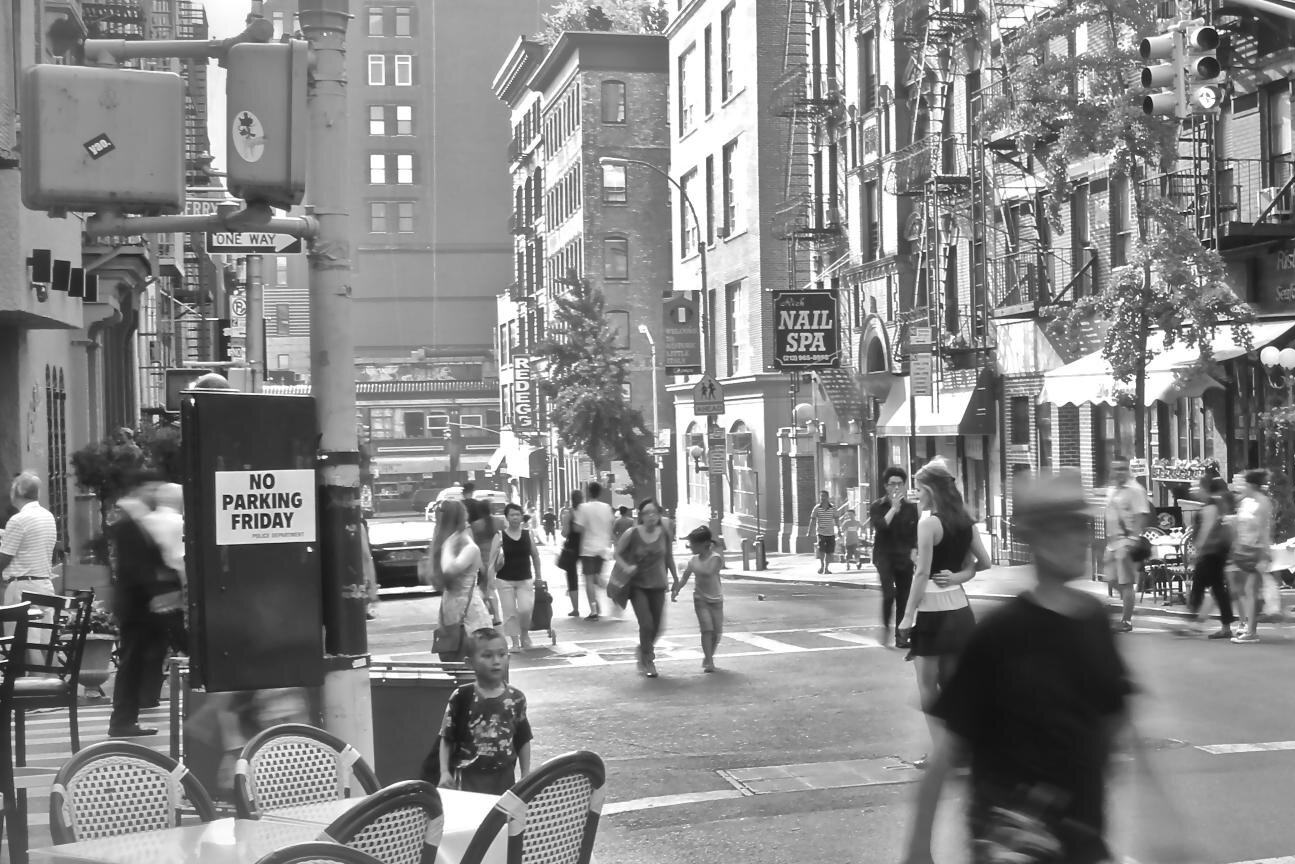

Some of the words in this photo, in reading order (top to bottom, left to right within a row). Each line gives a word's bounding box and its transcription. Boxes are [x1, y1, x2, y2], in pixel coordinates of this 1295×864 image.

[216, 233, 242, 245] ONE
[249, 233, 276, 245] WAY
[778, 310, 833, 330] NAIL
[785, 332, 826, 353] SPA
[249, 473, 276, 490] NO
[222, 492, 303, 511] PARKING
[231, 512, 295, 530] FRIDAY
